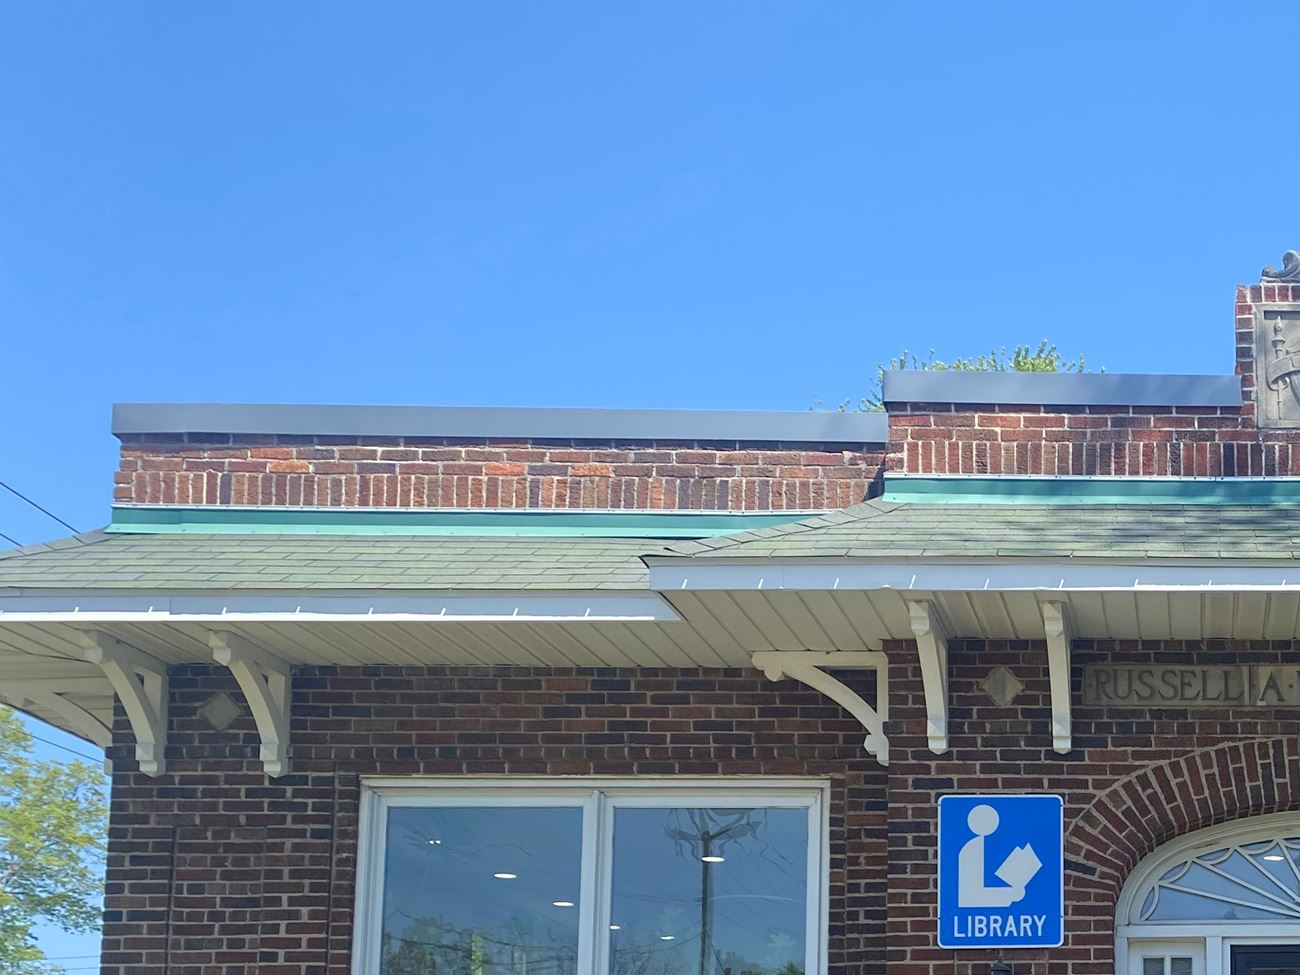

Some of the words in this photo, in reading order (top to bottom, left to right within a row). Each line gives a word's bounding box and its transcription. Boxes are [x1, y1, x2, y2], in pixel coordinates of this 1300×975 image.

[1095, 669, 1245, 700] RUSSELL
[1259, 671, 1285, 701] A
[953, 915, 1047, 937] LIBRARY
